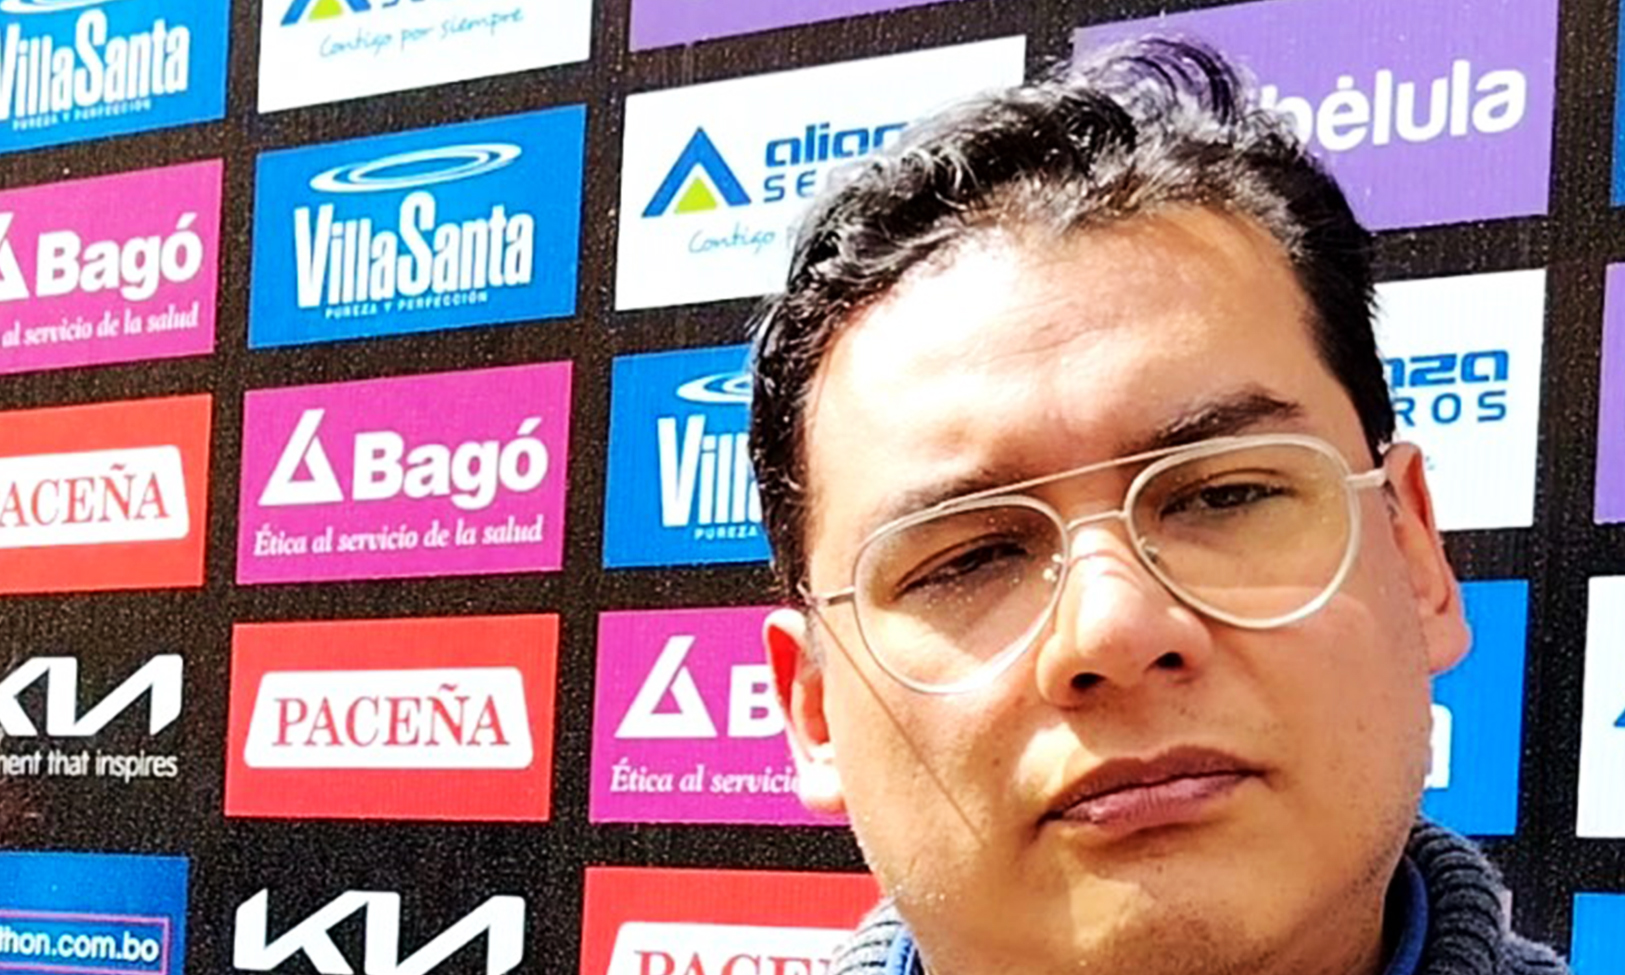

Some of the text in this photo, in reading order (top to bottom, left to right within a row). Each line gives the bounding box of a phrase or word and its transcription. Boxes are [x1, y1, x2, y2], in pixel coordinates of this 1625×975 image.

[320, 8, 524, 58] Contigo por siempre
[36, 212, 204, 301] Bagó
[688, 222, 776, 254] Contigo
[2, 320, 21, 348] al
[24, 315, 93, 344] servicio
[97, 310, 119, 339] de
[123, 308, 142, 335] la
[146, 301, 199, 332] salud
[325, 290, 488, 319] PUREZA Y PERFECCIÓN
[352, 417, 549, 511] Bagó
[253, 514, 544, 556] Ética al servicio de la salud
[694, 525, 758, 540] PUREZA
[272, 683, 511, 748] PACEÑA
[47, 750, 90, 776] that
[95, 749, 178, 784] inspires
[610, 757, 674, 793] Ética
[679, 764, 705, 792] al
